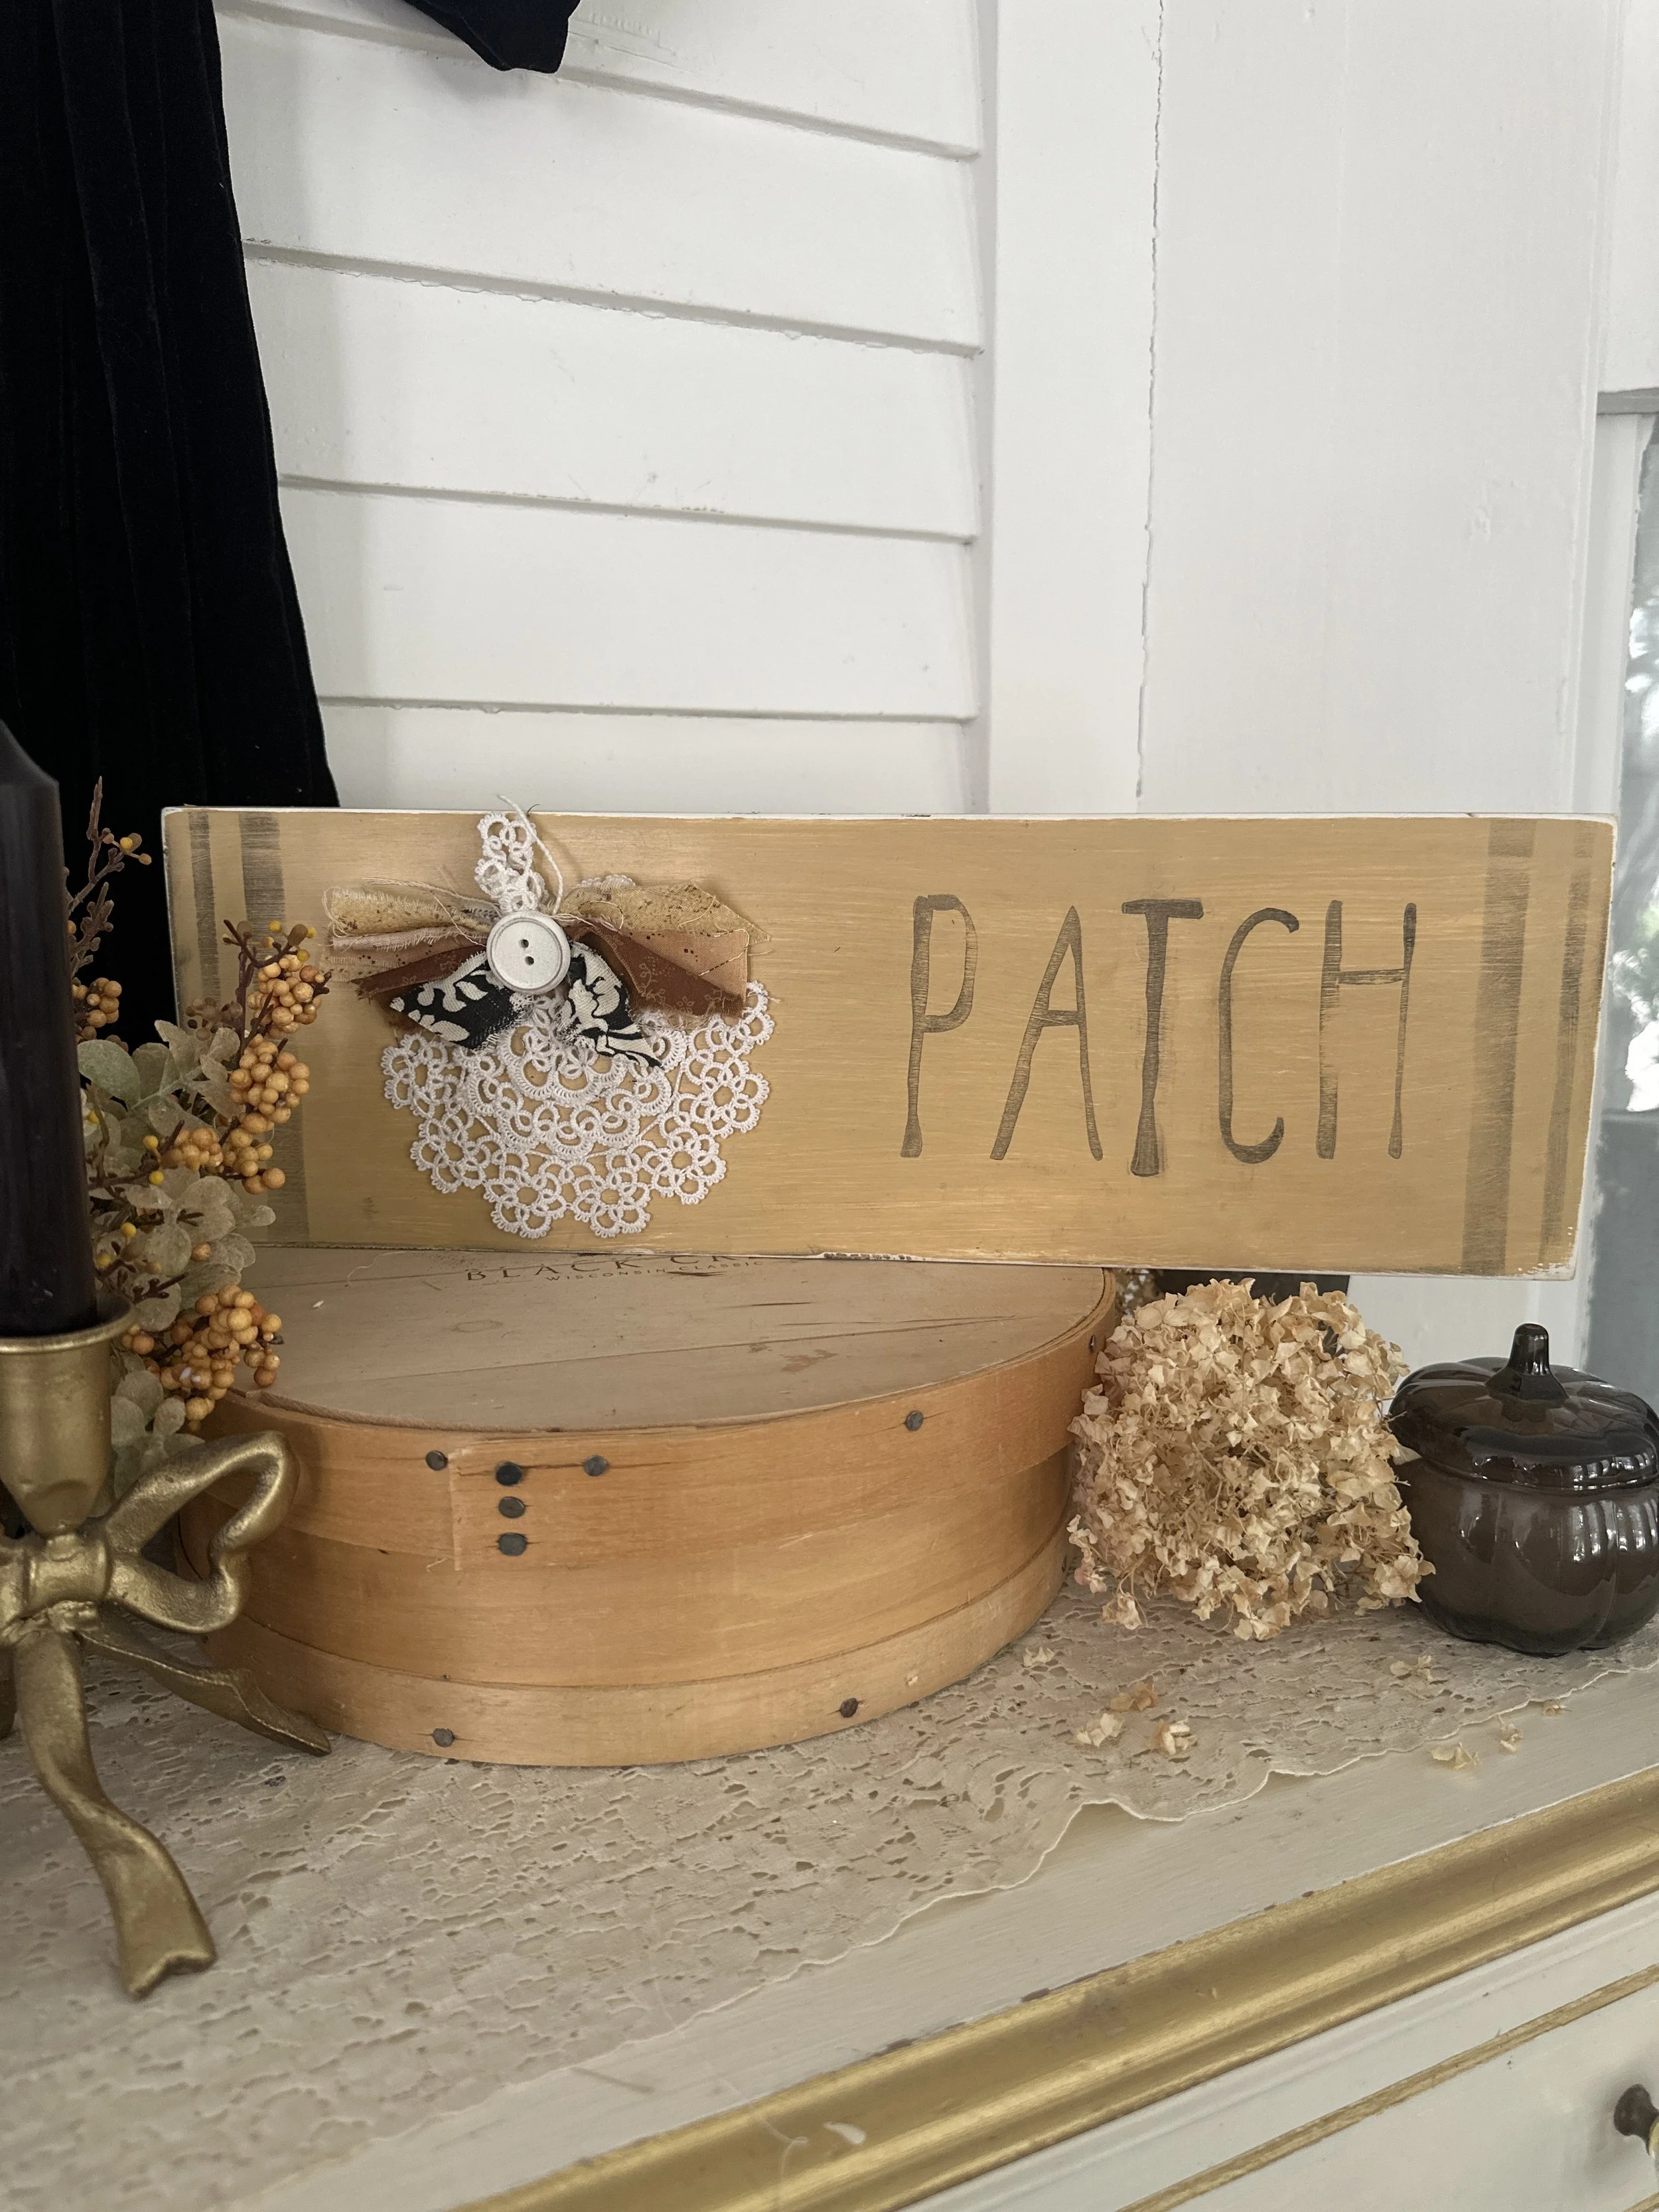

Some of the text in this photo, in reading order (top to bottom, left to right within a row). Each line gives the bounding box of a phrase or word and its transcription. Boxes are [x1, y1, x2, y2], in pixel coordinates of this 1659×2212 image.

[901, 894, 1417, 1177] PATCH
[465, 1257, 643, 1280] BLACK
[546, 1261, 763, 1281] WISCONSIN CLASSIC
